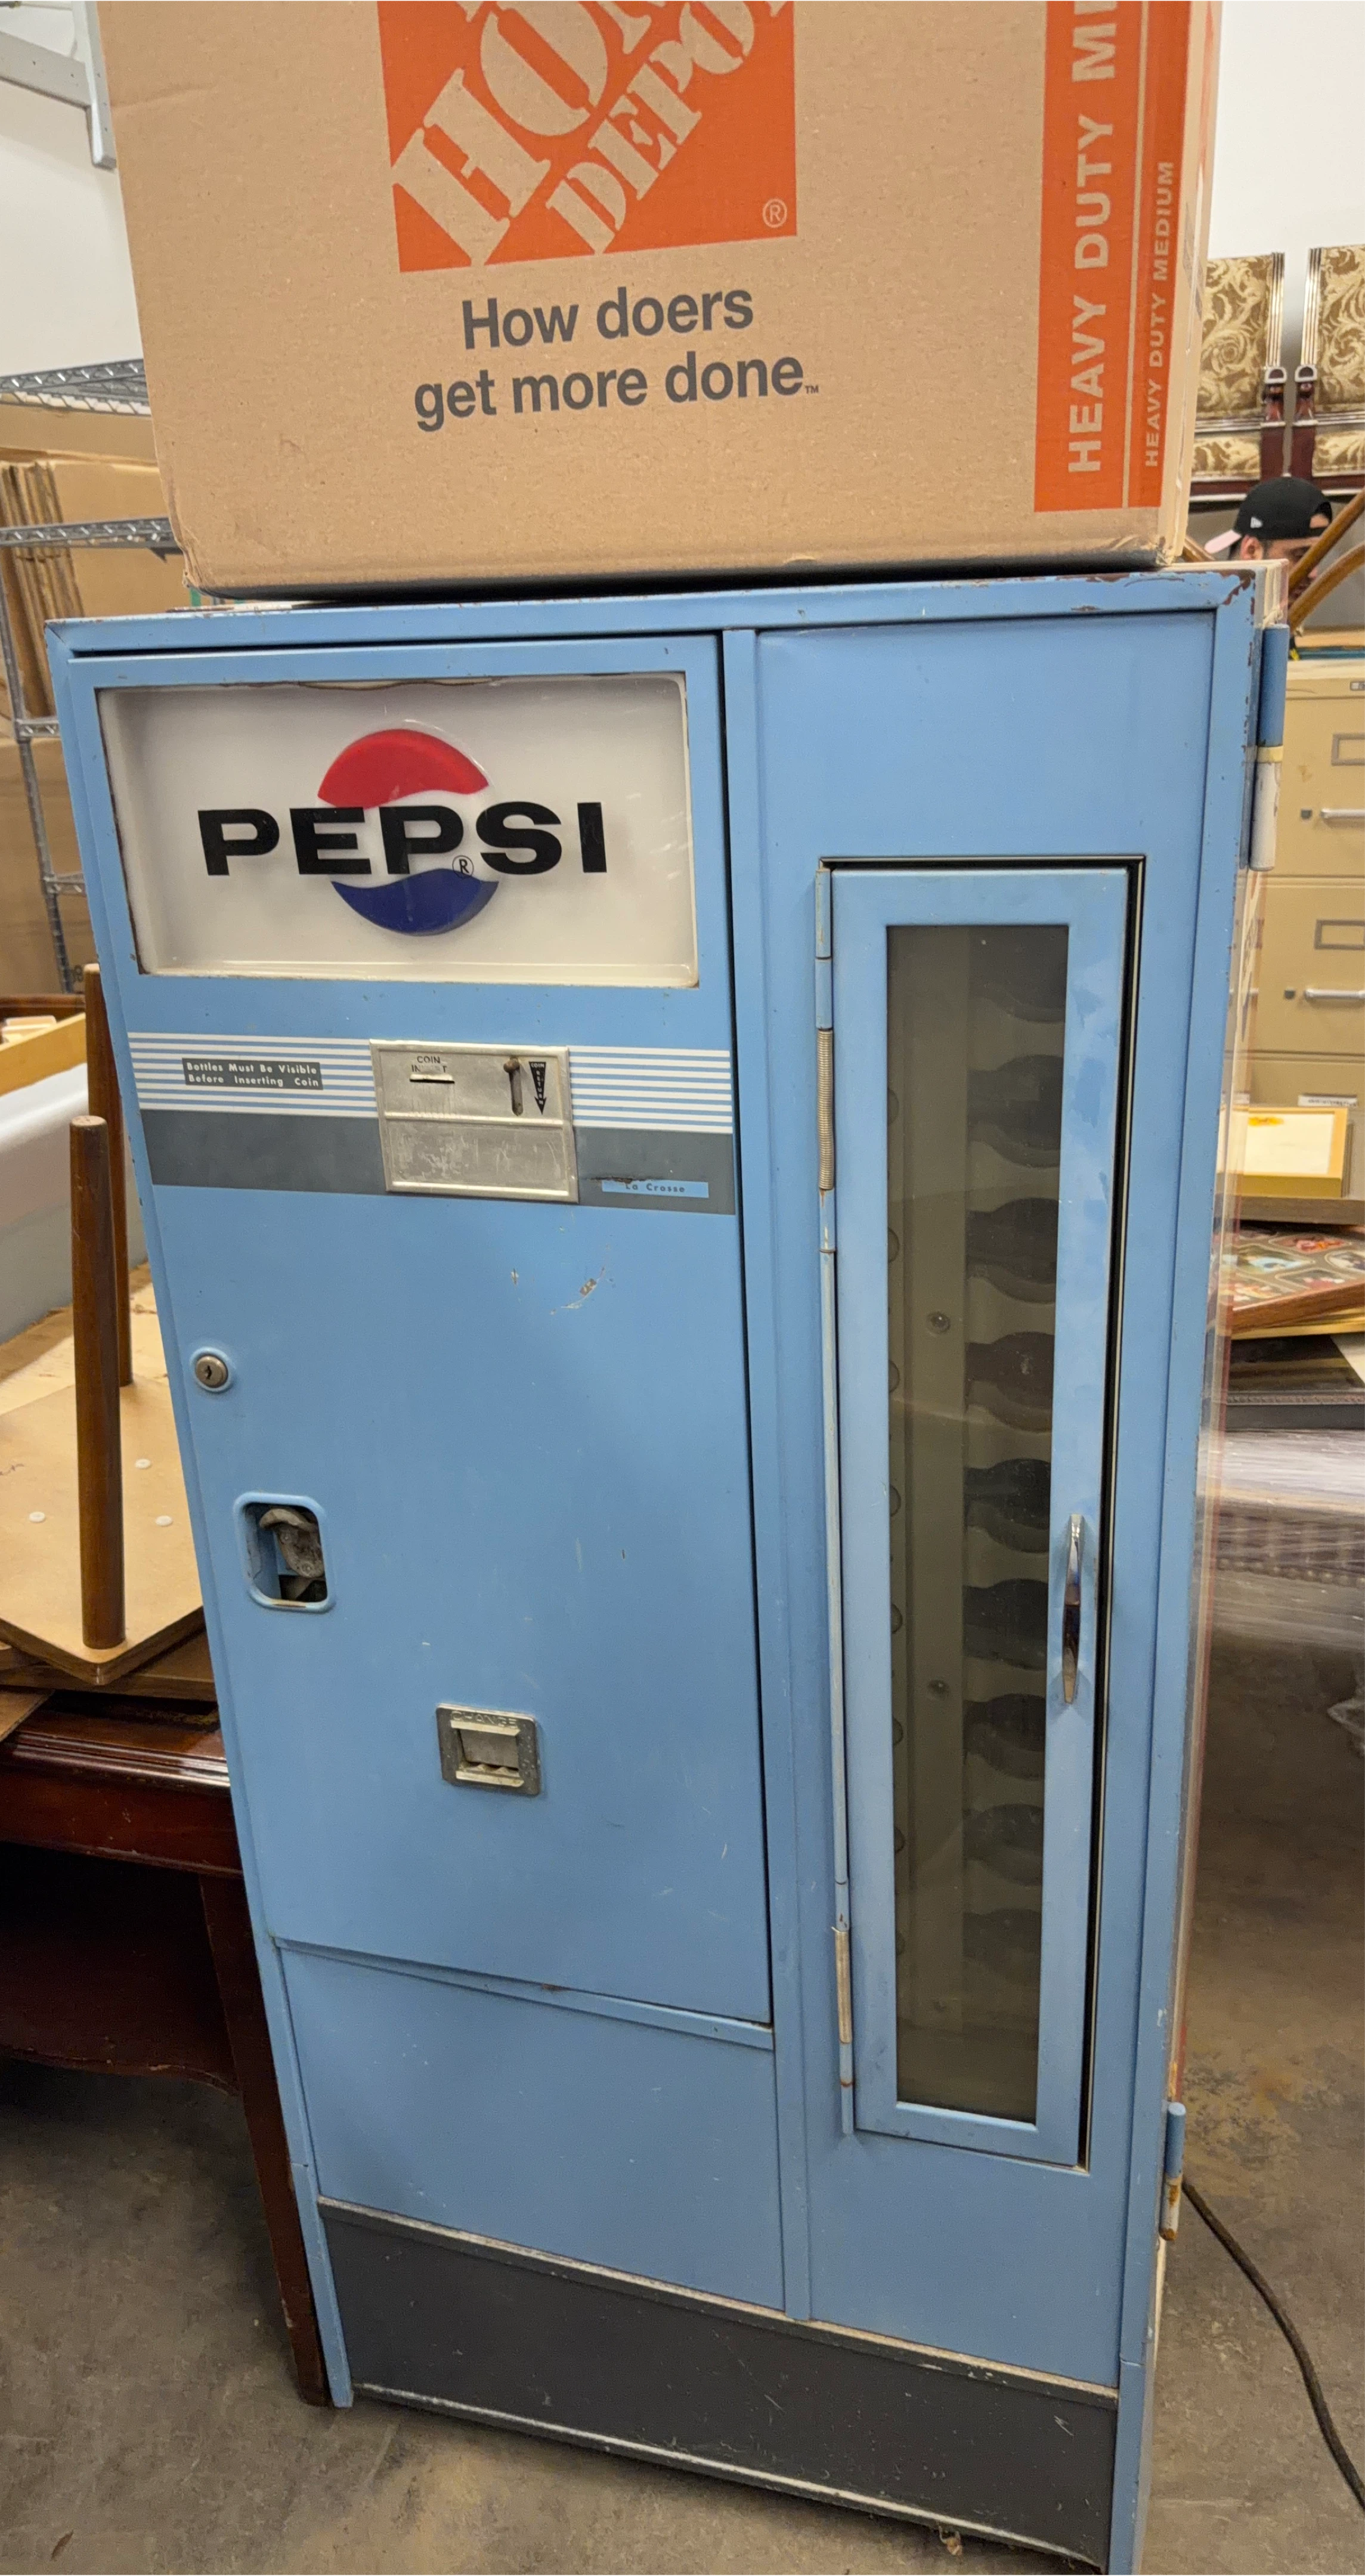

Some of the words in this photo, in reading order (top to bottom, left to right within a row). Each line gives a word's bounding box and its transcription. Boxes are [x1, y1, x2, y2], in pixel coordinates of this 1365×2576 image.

[391, 0, 667, 267] HO
[545, 0, 788, 255] DEPO
[1074, 114, 1113, 270] DUTY
[1153, 162, 1175, 281] MEDIUM
[462, 298, 578, 349] How
[596, 287, 754, 339] doers
[1150, 293, 1167, 368] DUTY
[414, 369, 496, 432] get
[512, 367, 647, 413] more
[1068, 295, 1106, 472] HEAVY
[1146, 379, 1163, 467] HEAVY
[197, 801, 607, 876] PEPSI
[187, 1063, 223, 1072] Bottles
[228, 1063, 254, 1073] Must
[260, 1064, 273, 1073] Be
[278, 1065, 317, 1074] Visible
[188, 1075, 224, 1083] Before
[235, 1076, 283, 1088] Inserting
[295, 1078, 318, 1087] Coin
[646, 1183, 685, 1193] Crosse
